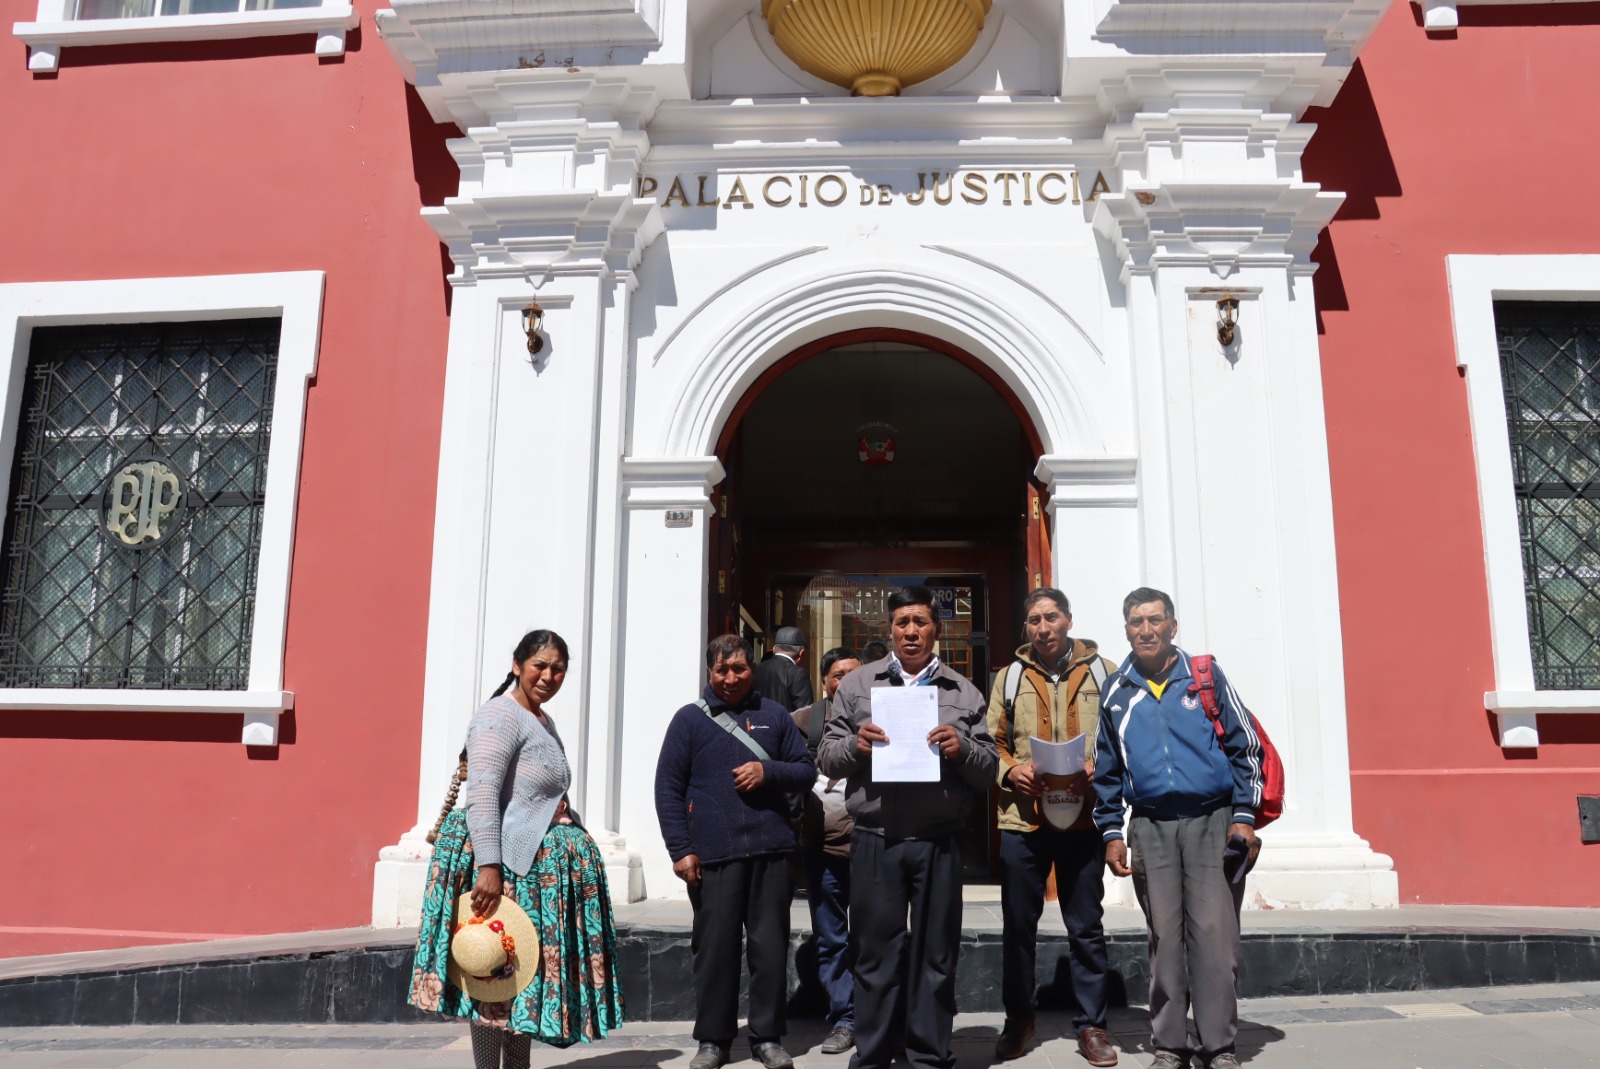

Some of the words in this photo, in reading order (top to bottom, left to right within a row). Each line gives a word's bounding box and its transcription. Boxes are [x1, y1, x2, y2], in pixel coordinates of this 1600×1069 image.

[636, 173, 848, 209] PALACIO
[859, 184, 893, 206] DE
[905, 169, 1112, 206] JUSTICIA
